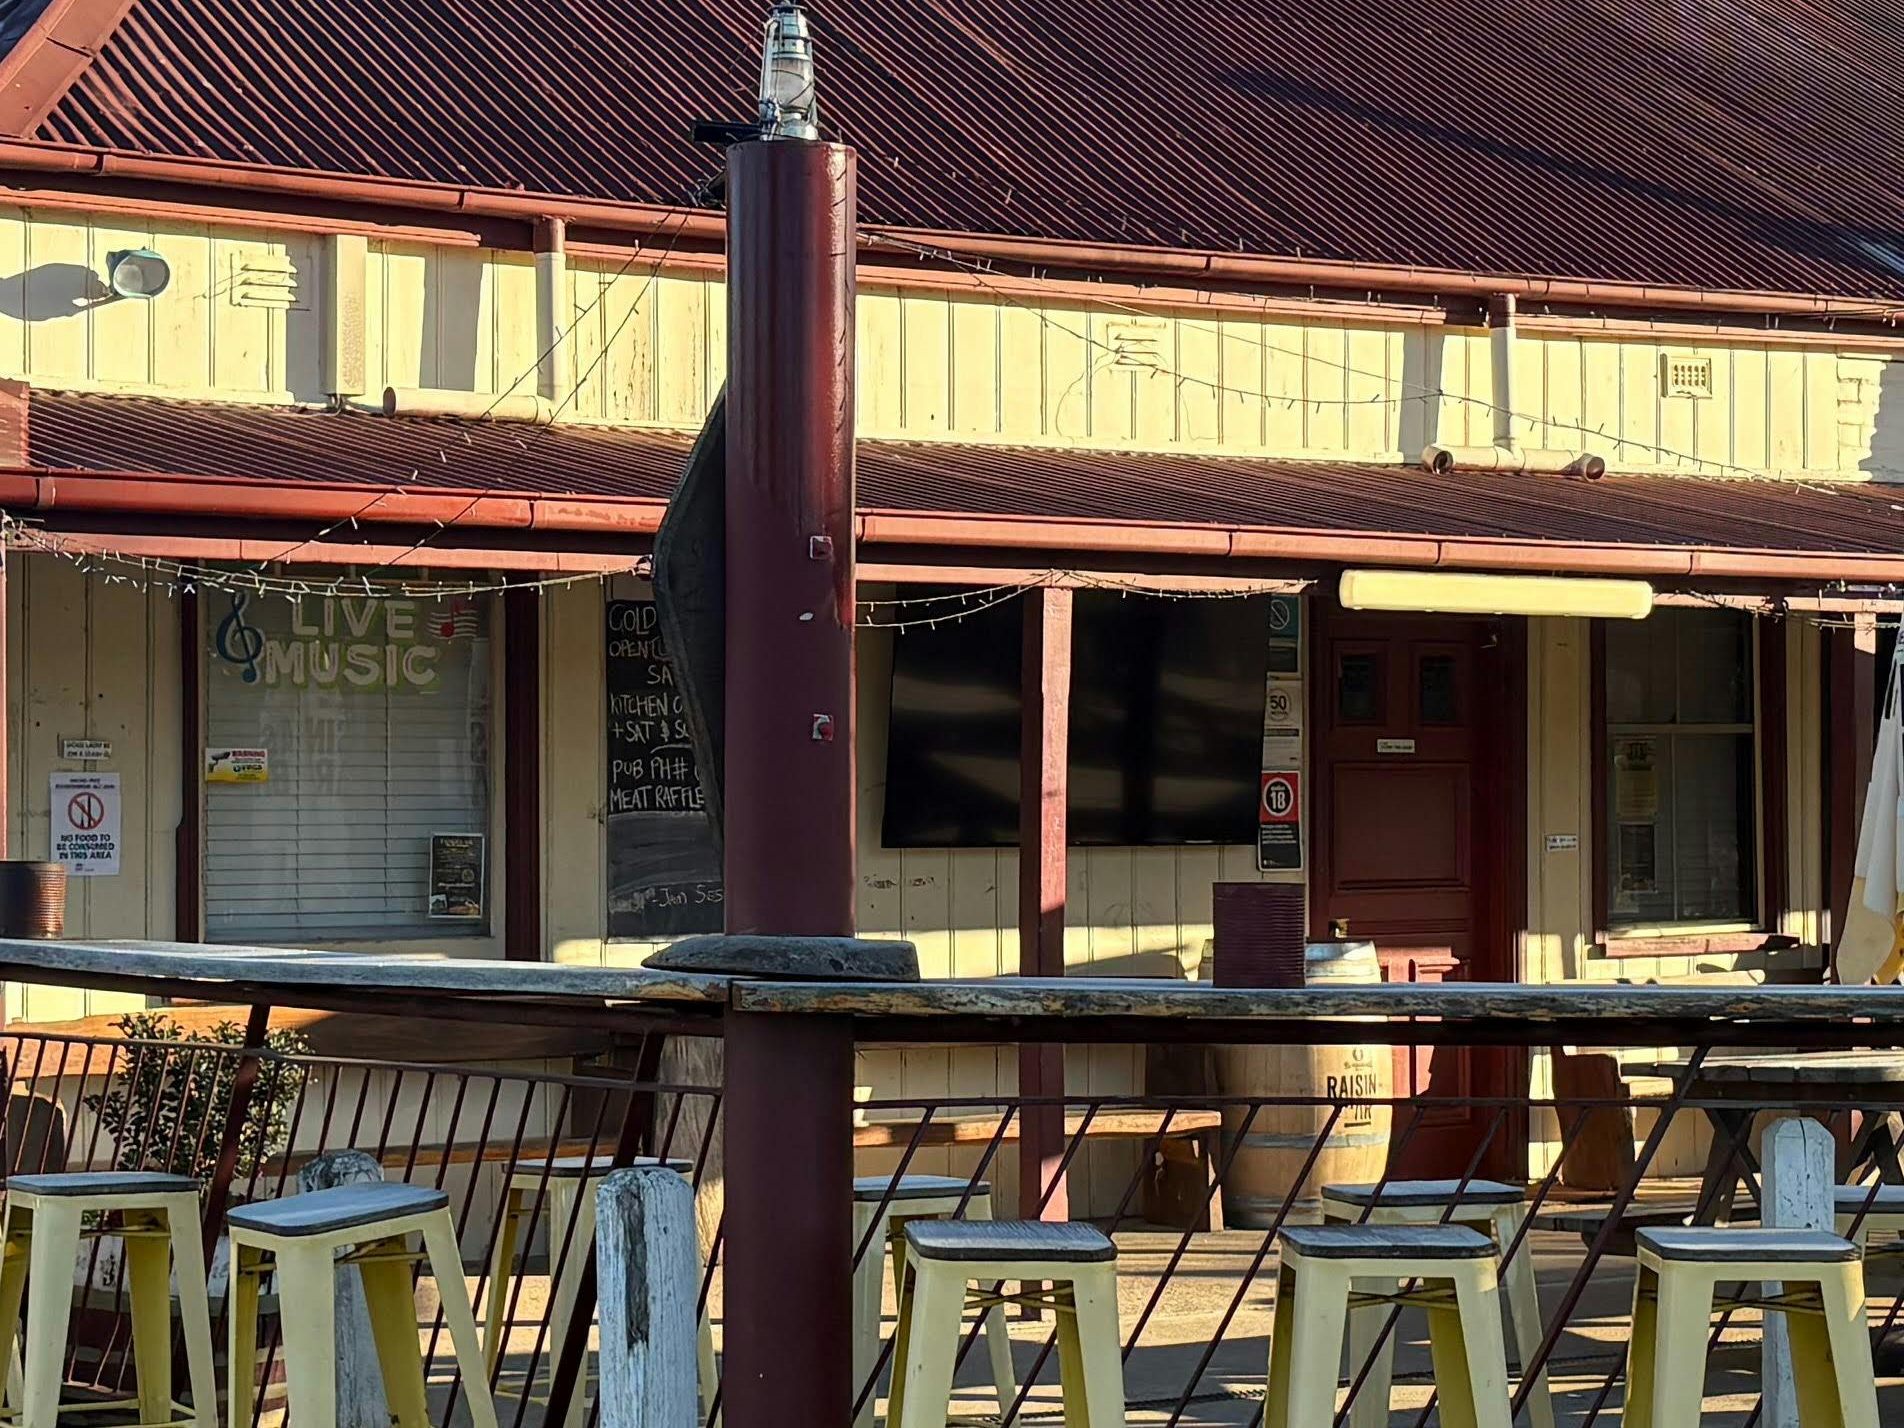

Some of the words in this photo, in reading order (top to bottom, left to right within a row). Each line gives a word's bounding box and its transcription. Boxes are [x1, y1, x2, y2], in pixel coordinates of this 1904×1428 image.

[291, 597, 415, 638] LIVE
[264, 639, 437, 686] MUSIC
[610, 692, 668, 717] KITCHEN
[1269, 694, 1288, 712] 50
[612, 759, 644, 783] PUB
[610, 785, 653, 812] MEAT
[1270, 791, 1287, 810] 18
[1326, 1074, 1377, 1100] RAISIN
